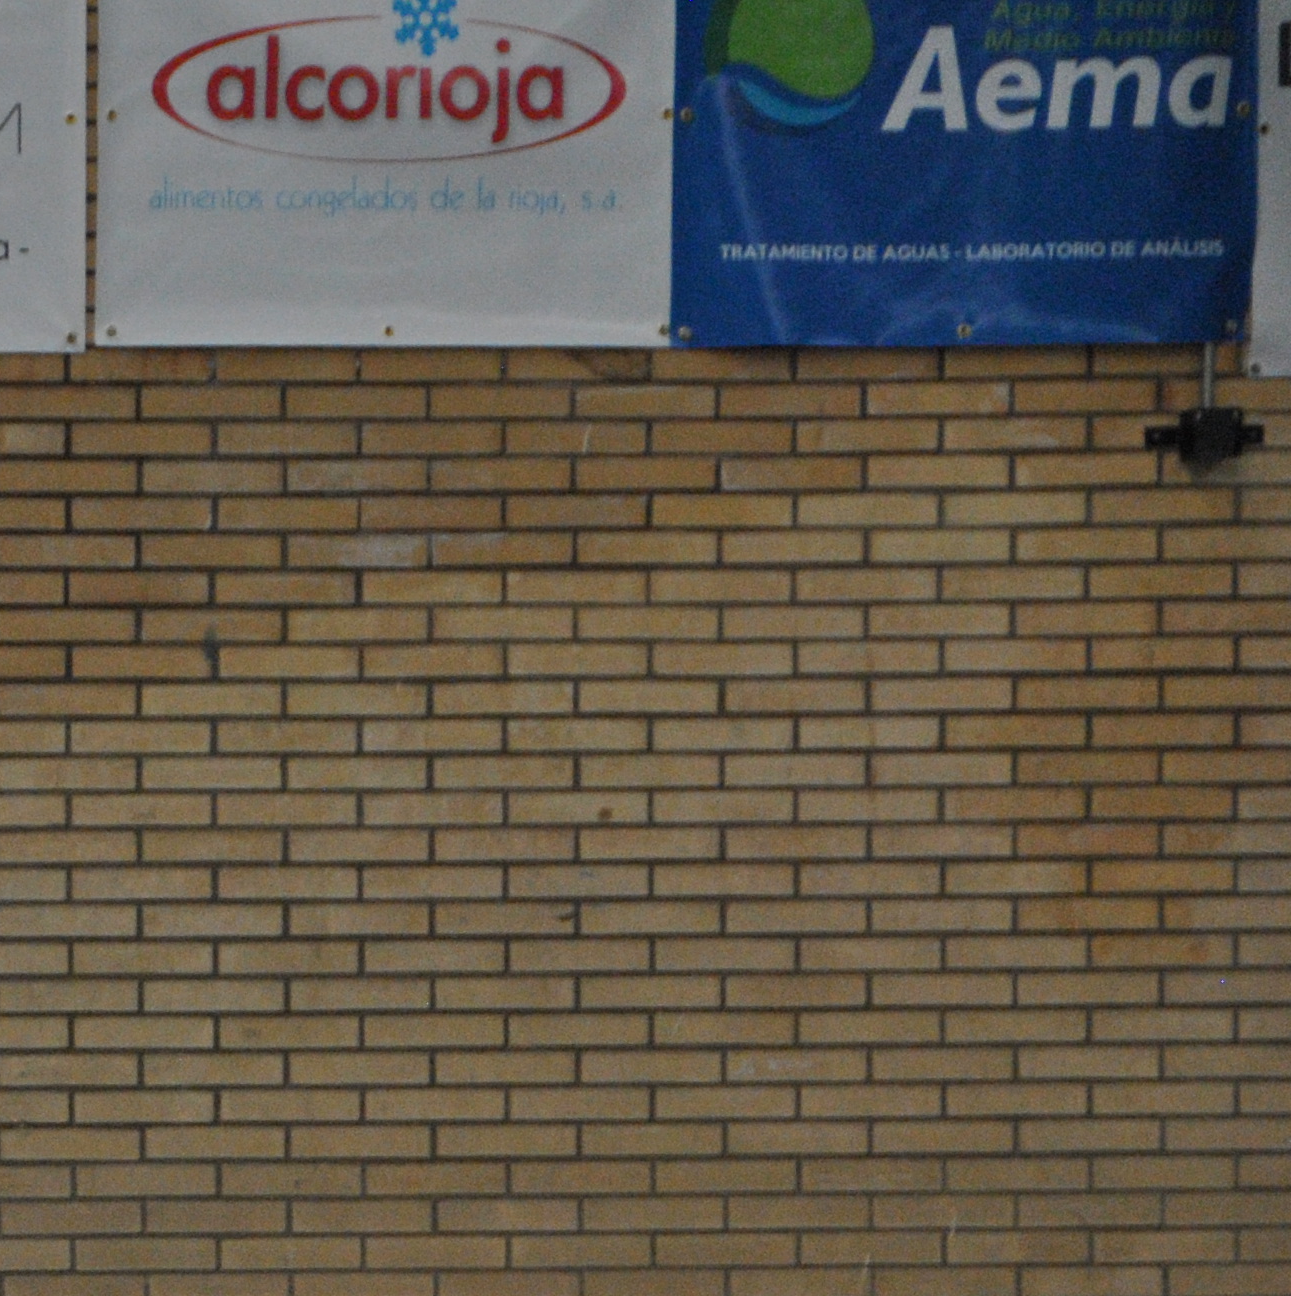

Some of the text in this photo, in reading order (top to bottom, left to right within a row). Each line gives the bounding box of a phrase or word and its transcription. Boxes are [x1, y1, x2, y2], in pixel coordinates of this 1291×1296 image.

[206, 35, 564, 144] alcorioja
[880, 25, 1233, 133] Aema
[149, 175, 262, 211] alimentos
[276, 174, 418, 217] congelados
[430, 175, 473, 211] de
[478, 175, 496, 211] la
[720, 243, 848, 262] TRATAMIENTO
[852, 244, 877, 262] DE
[882, 243, 950, 262] AGUAS
[965, 241, 1106, 261] LABORATORIO
[1111, 240, 1136, 258] DE
[1141, 237, 1224, 257] ANÁLISIS
